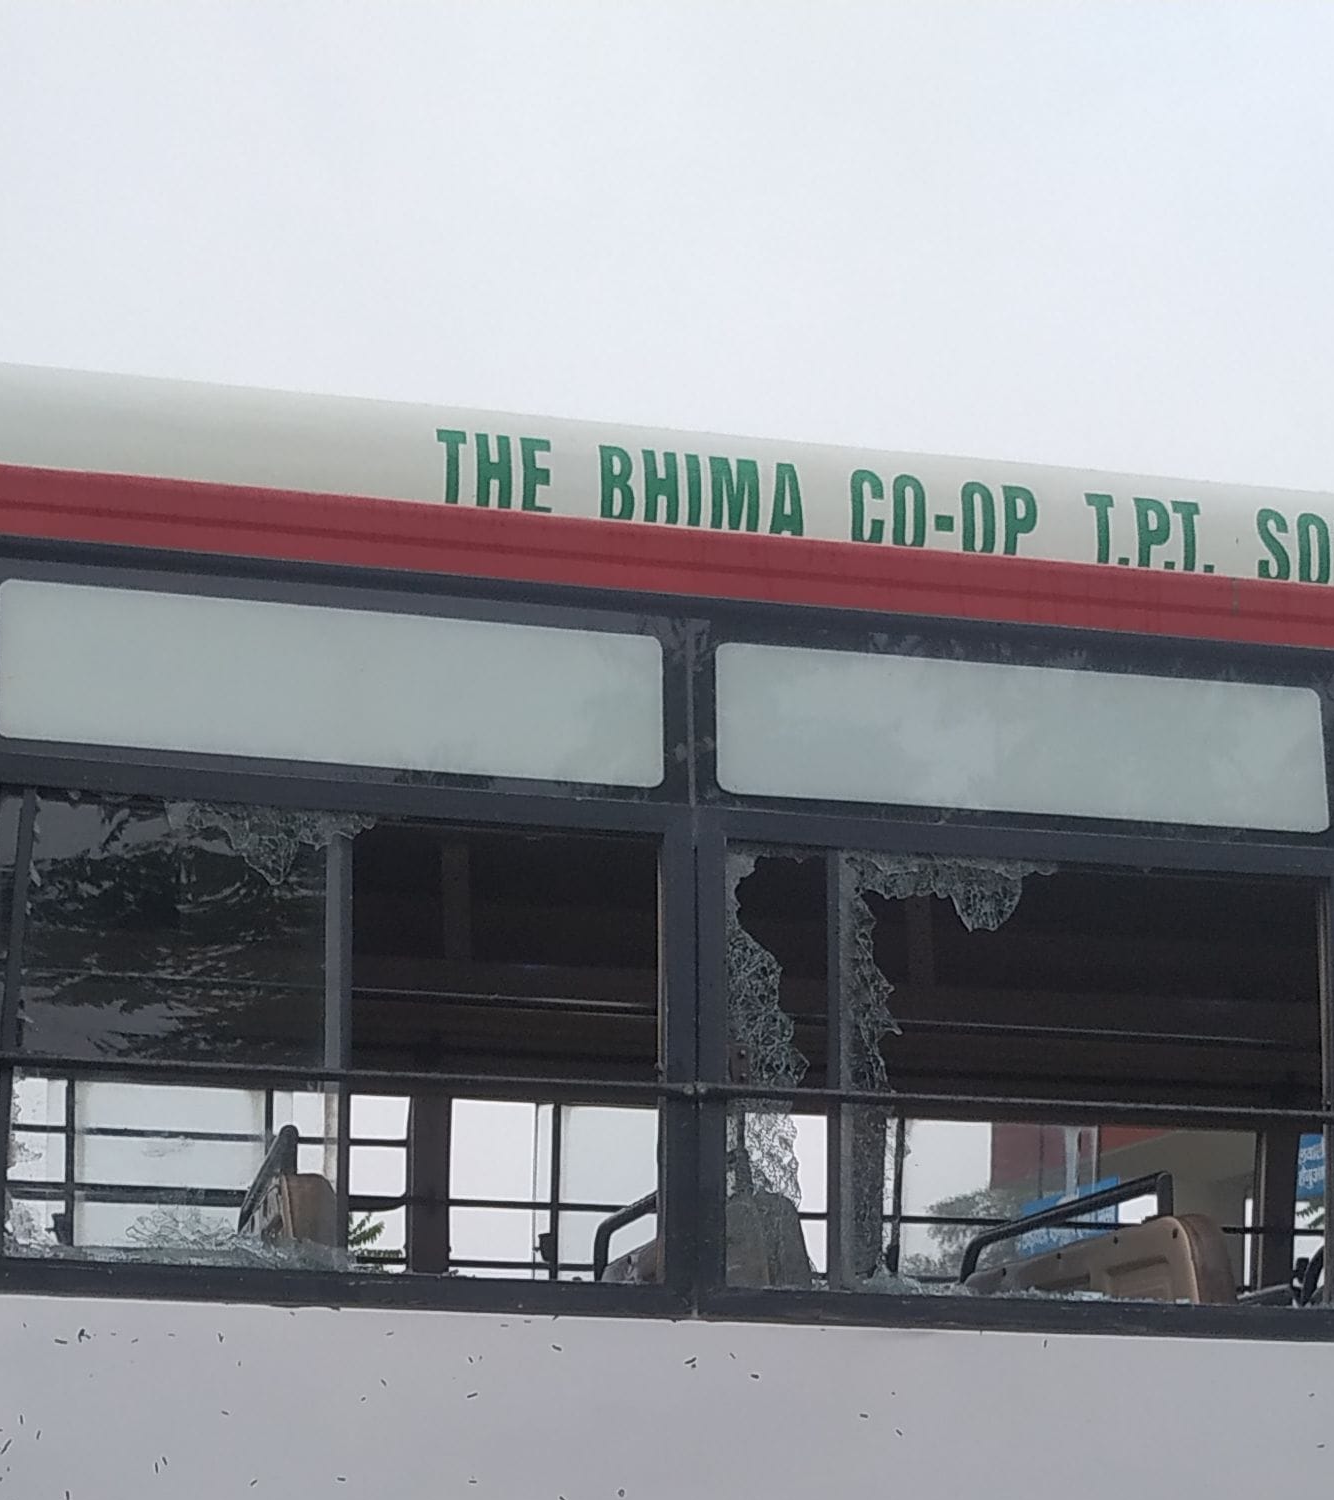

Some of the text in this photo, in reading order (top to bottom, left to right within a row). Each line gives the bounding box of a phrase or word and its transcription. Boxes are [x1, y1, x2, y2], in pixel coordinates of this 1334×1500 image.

[436, 429, 552, 512] THE
[599, 445, 805, 537] BHIMA
[851, 469, 1038, 556] CO-OP
[1085, 493, 1215, 573] T.P.T.
